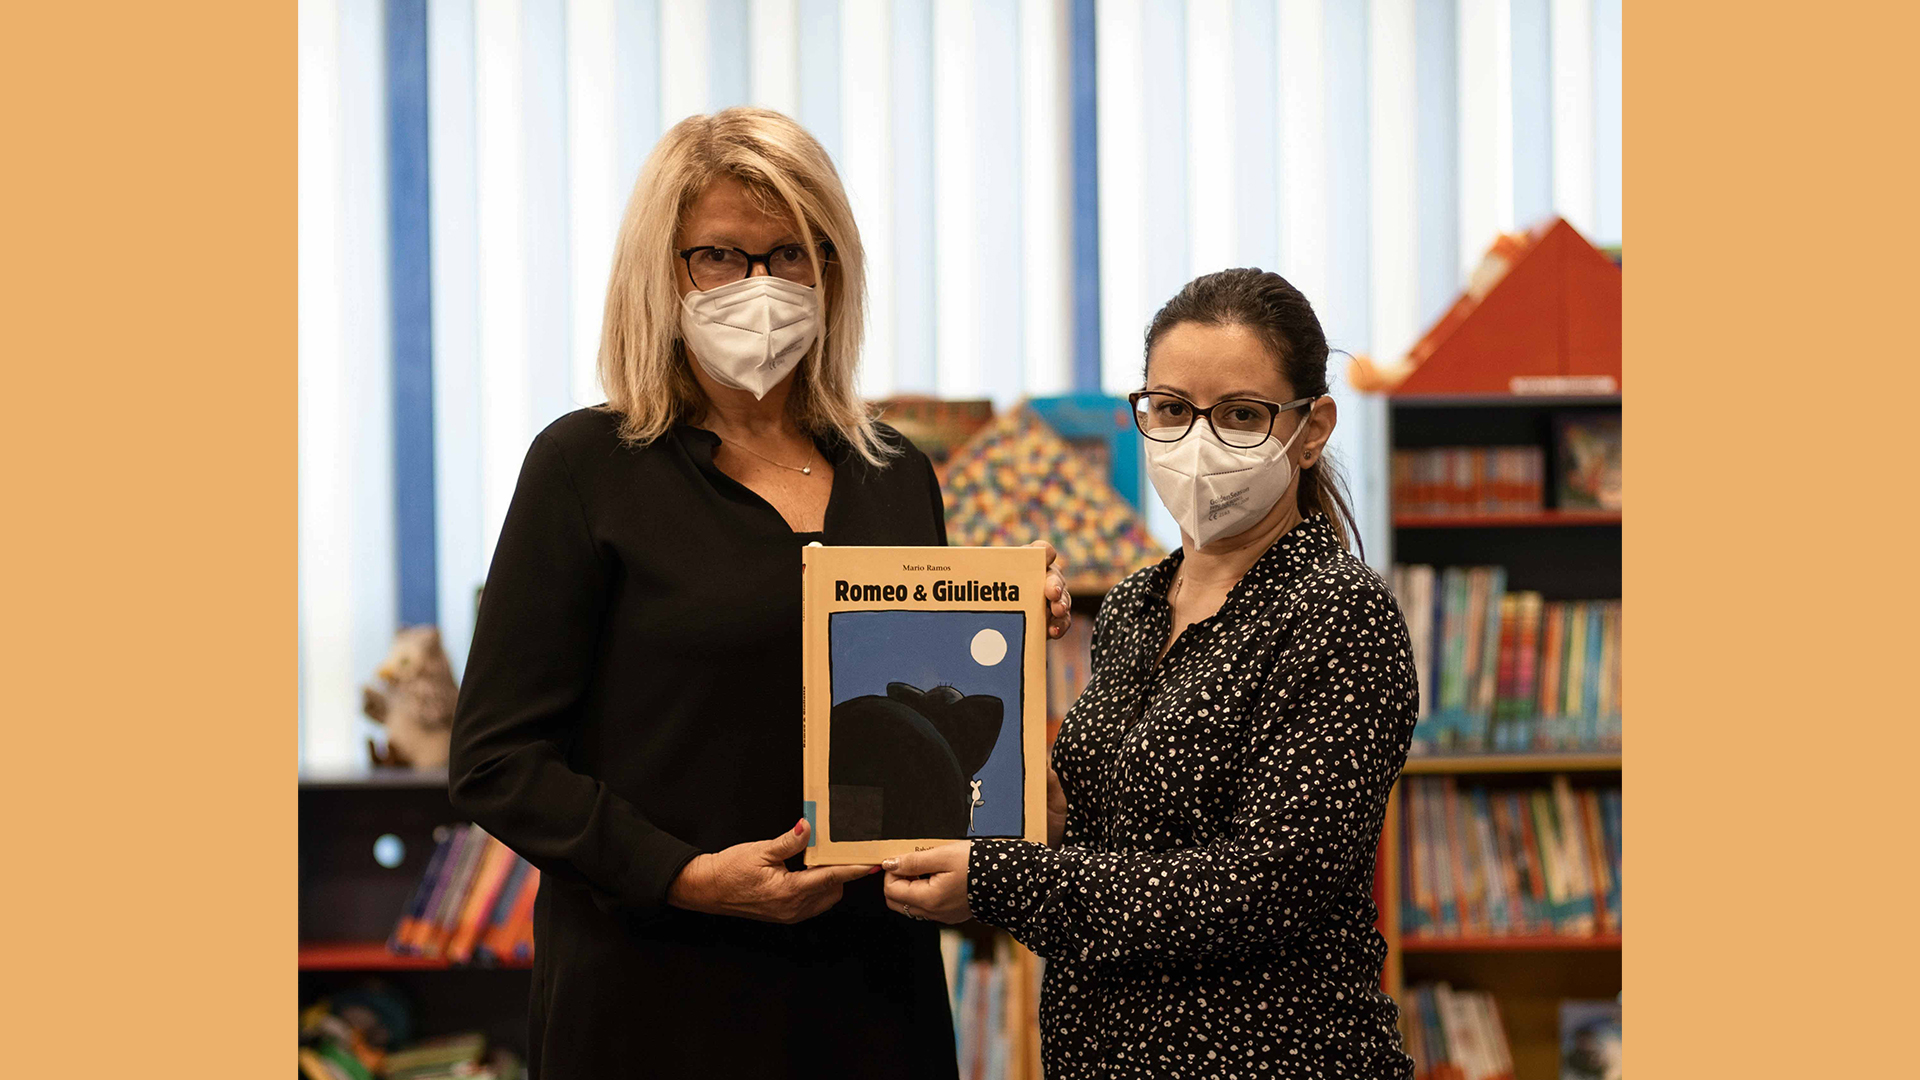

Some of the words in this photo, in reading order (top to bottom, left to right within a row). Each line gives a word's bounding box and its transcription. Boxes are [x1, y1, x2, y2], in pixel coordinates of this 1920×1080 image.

[835, 580, 908, 602] Romeo
[913, 584, 927, 602] &
[932, 580, 1020, 602] Giulietta
